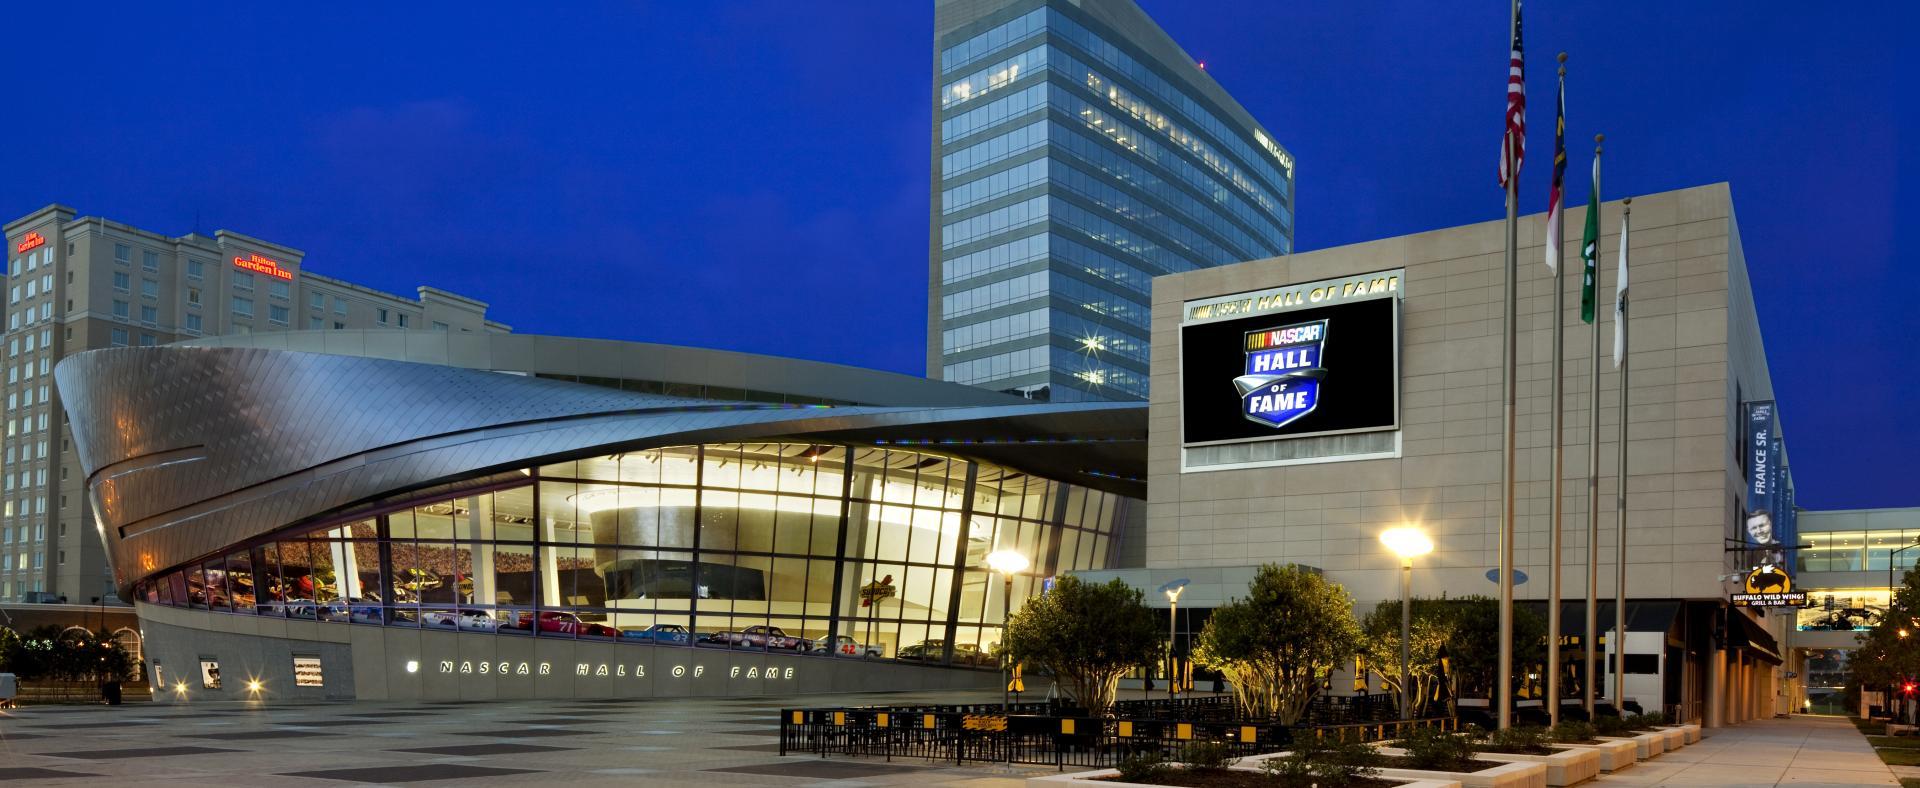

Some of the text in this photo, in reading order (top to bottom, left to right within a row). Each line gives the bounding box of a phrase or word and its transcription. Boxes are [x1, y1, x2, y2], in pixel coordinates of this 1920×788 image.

[234, 256, 292, 280] Garden Inn
[251, 254, 277, 268] Hilton
[1257, 291, 1304, 311] HALL
[1310, 285, 1337, 303] OF
[1343, 276, 1398, 298] FAME
[1270, 324, 1320, 346] NASCAR
[1254, 349, 1312, 373] HALL
[1271, 383, 1288, 393] OF
[1249, 391, 1308, 414] FAME
[1756, 429, 1767, 447] SR.
[1755, 449, 1767, 495] FRANCE
[559, 621, 573, 633] 71
[768, 636, 786, 648] 22
[841, 644, 856, 655] 42
[440, 661, 794, 679] NASCAR HALL OF FAME
